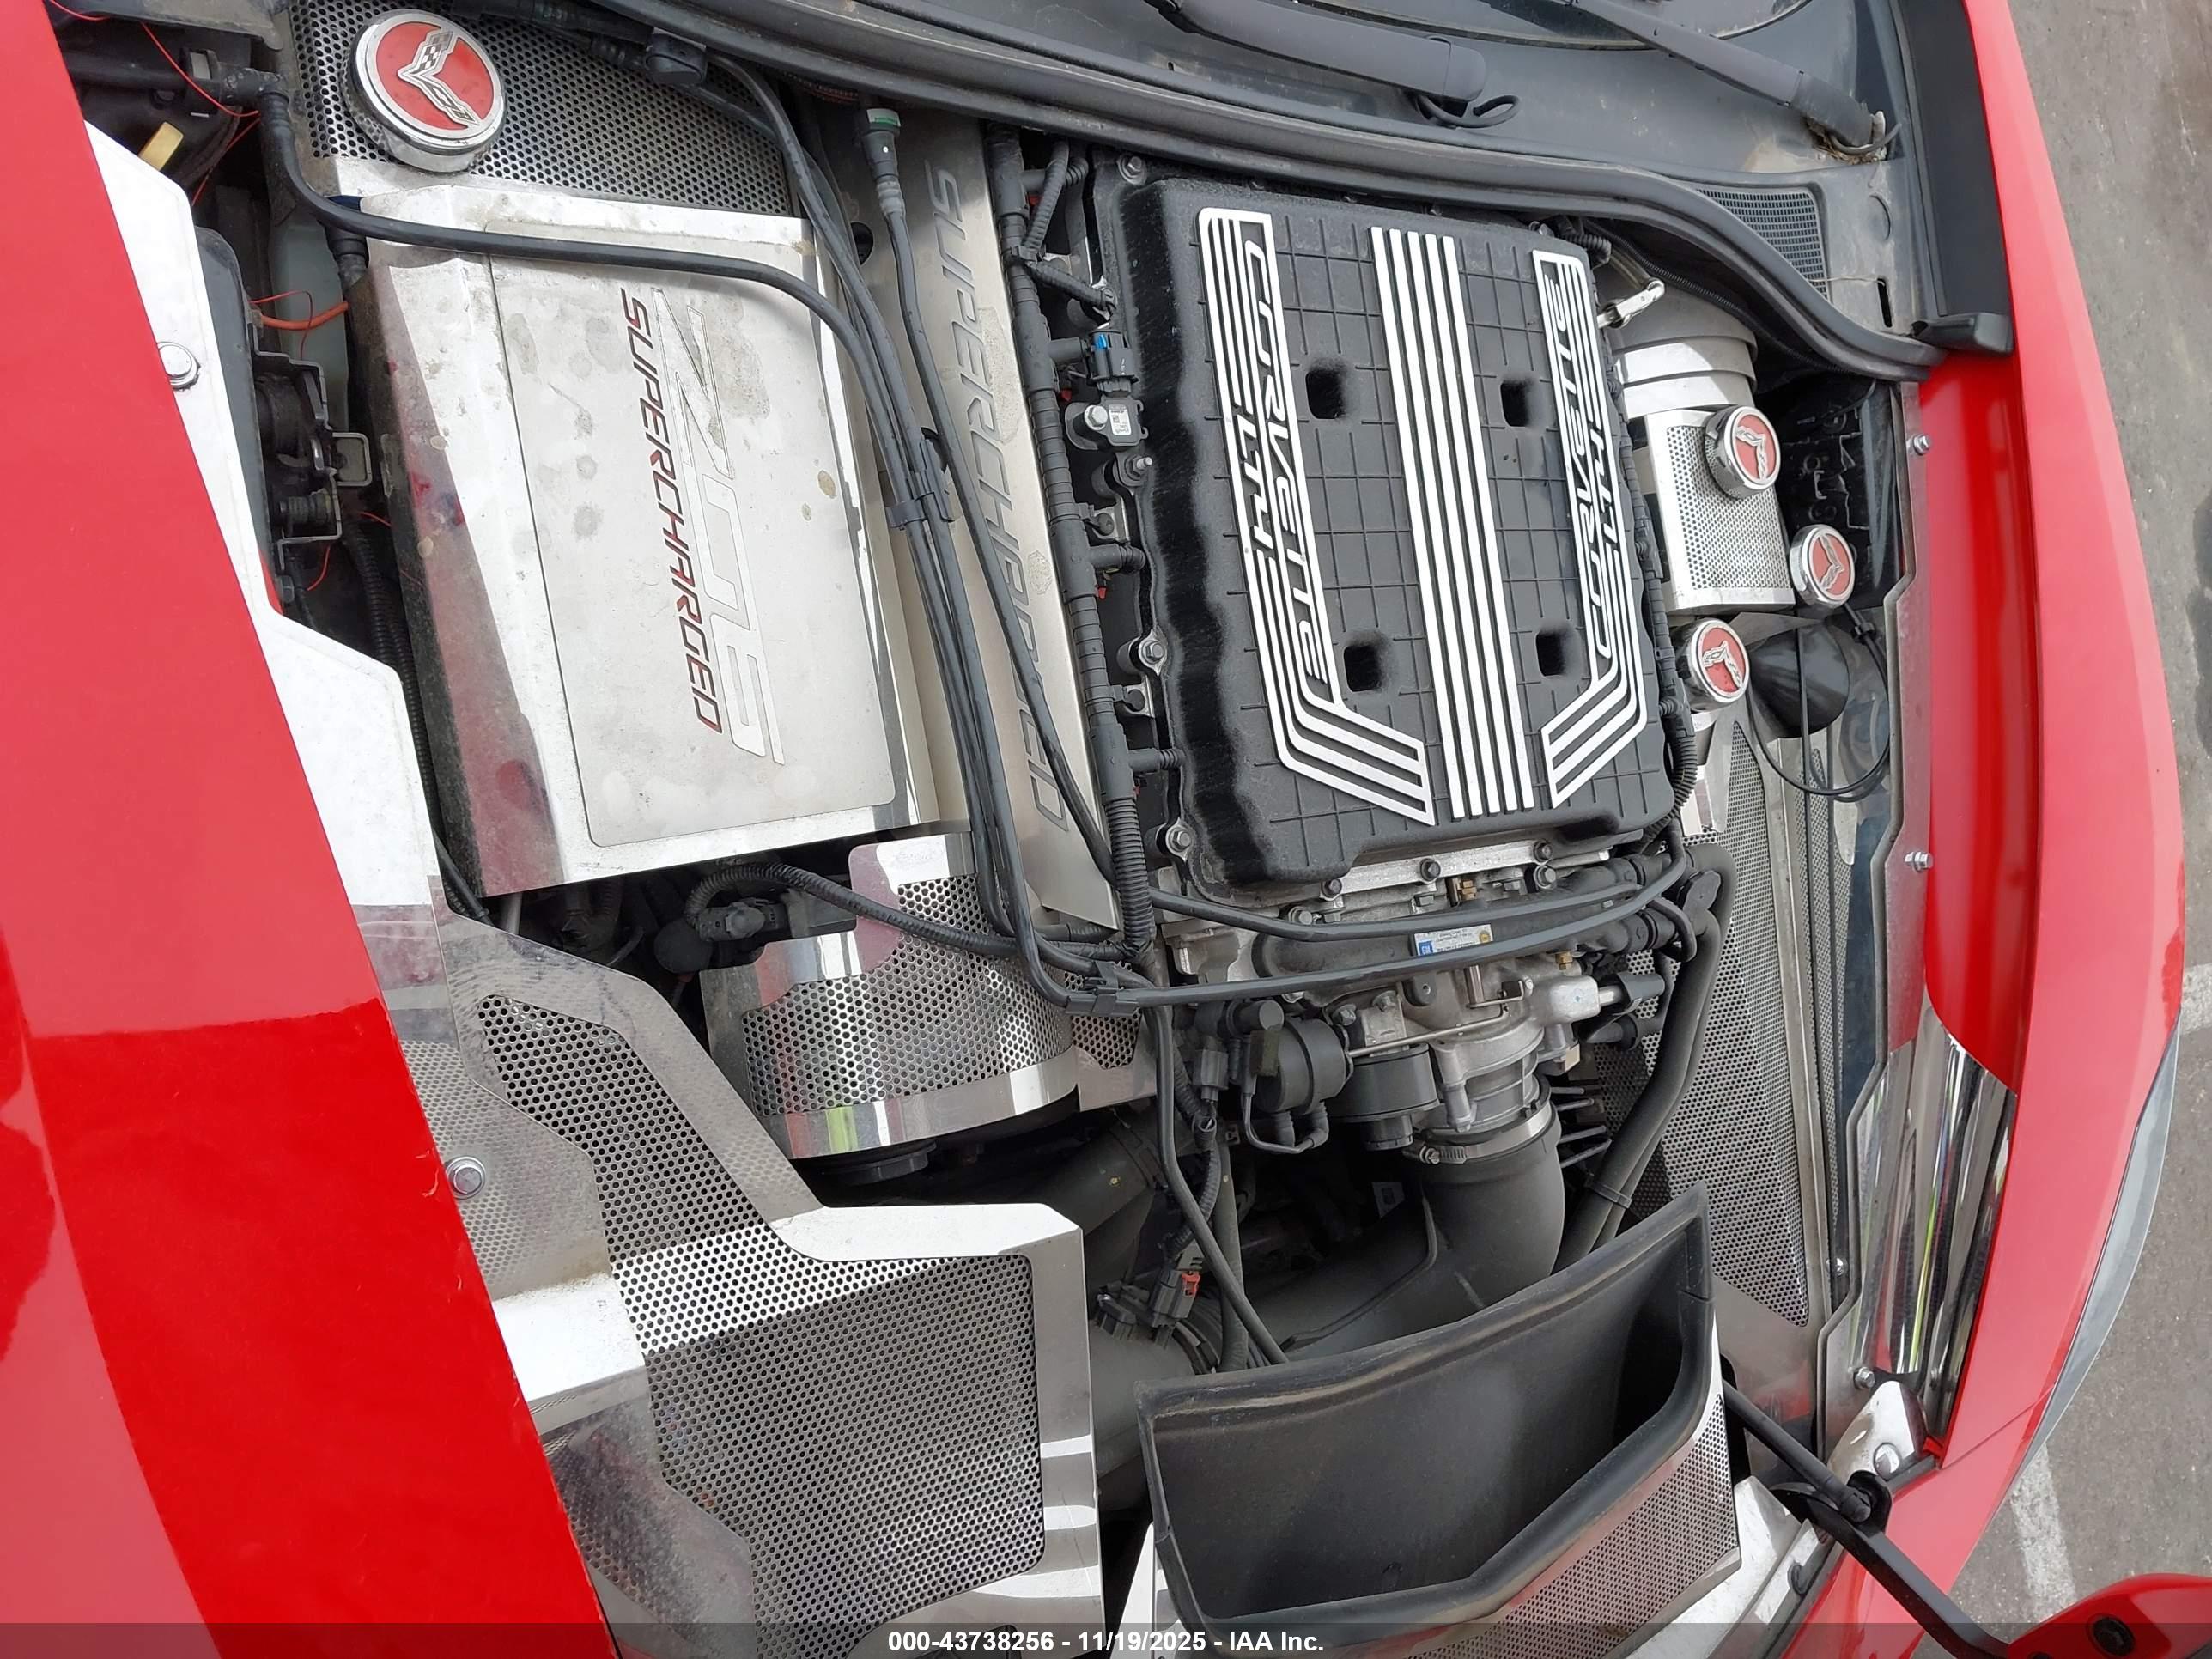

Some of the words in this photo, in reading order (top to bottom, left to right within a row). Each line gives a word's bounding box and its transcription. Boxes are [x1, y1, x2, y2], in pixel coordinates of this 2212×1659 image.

[620, 288, 722, 733] SUPERCHARGED
[651, 288, 784, 765] Z06
[1235, 413, 1273, 550] LT4
[1245, 239, 1329, 684] CORVETTE
[1544, 272, 1612, 659] CORVETTE
[1588, 419, 1619, 544] LT4
